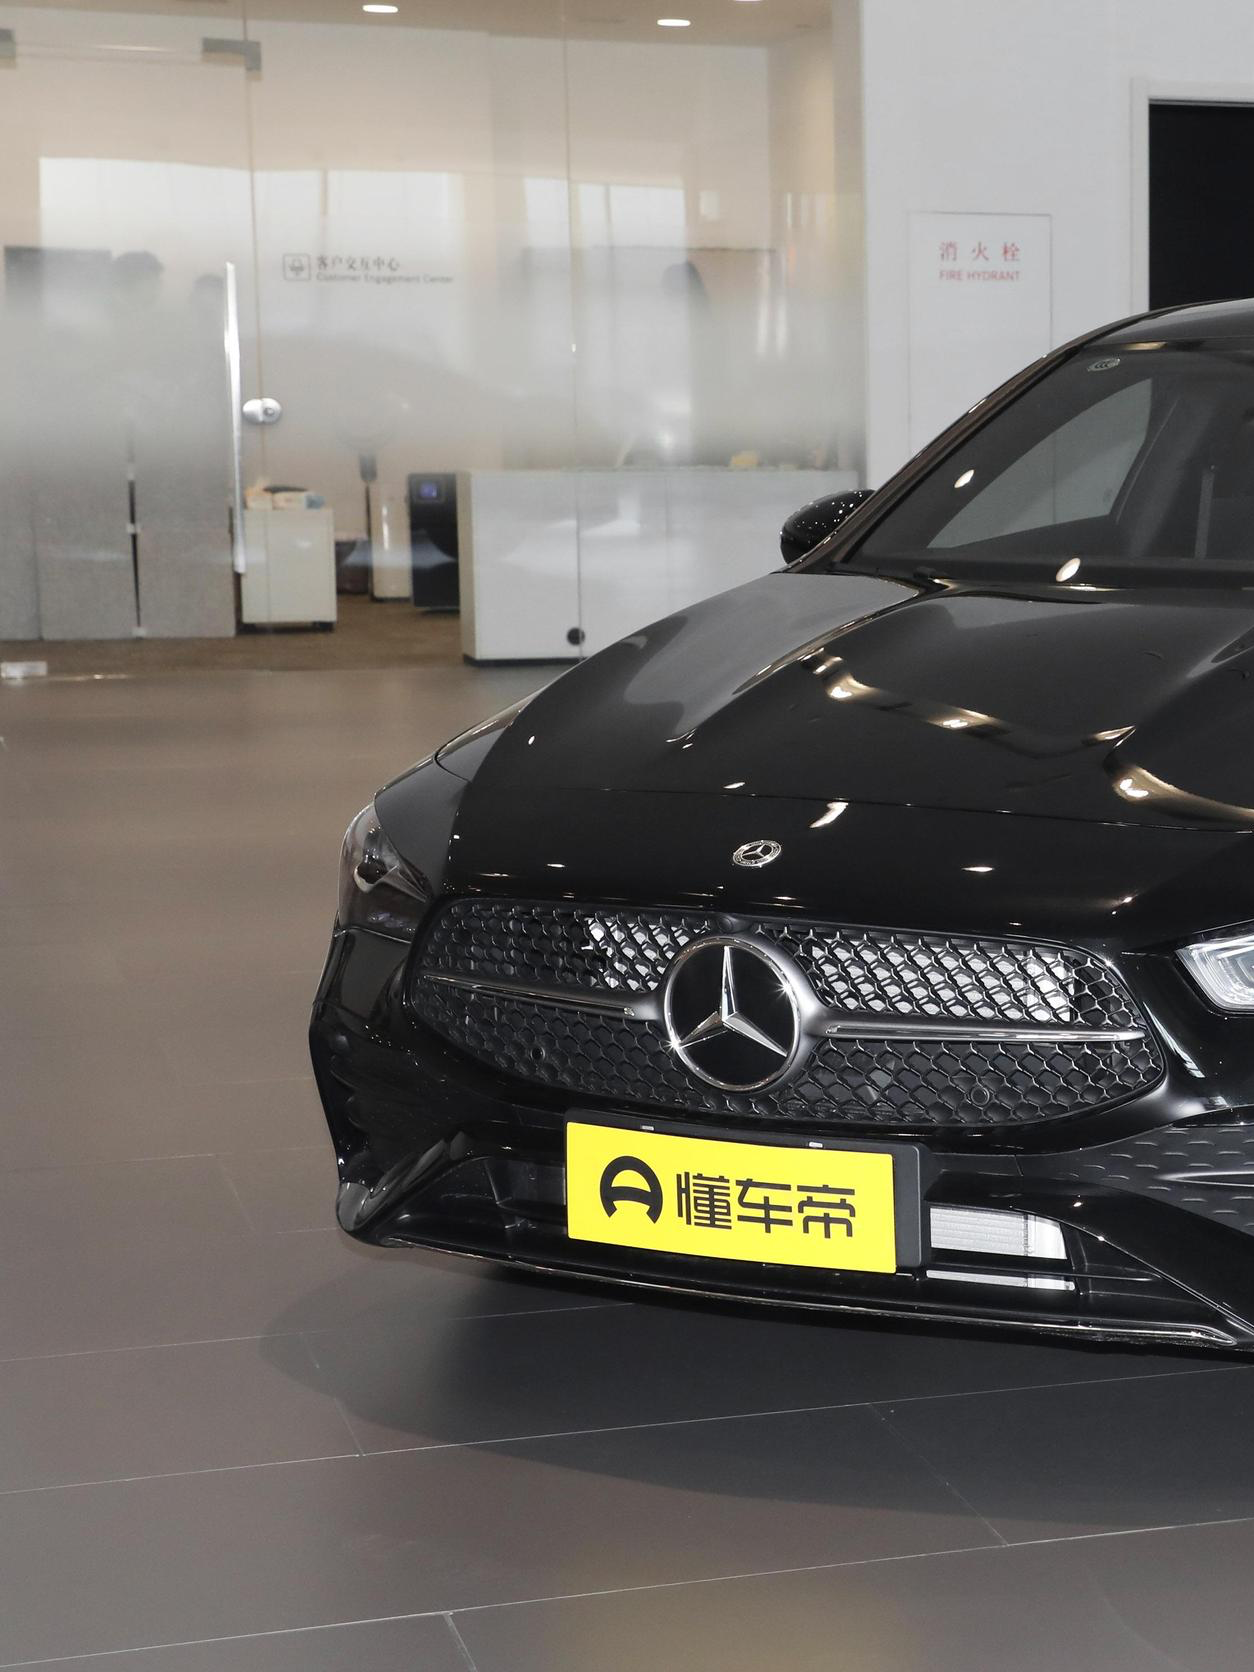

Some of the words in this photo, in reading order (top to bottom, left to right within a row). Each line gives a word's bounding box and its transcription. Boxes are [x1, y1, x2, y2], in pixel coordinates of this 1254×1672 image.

[939, 241, 1021, 262] 消火栓
[317, 254, 401, 272] 客户交互中心
[938, 270, 962, 281] FIRE
[966, 270, 1021, 281] HYDRANT
[676, 1171, 856, 1239] 懂车帝
